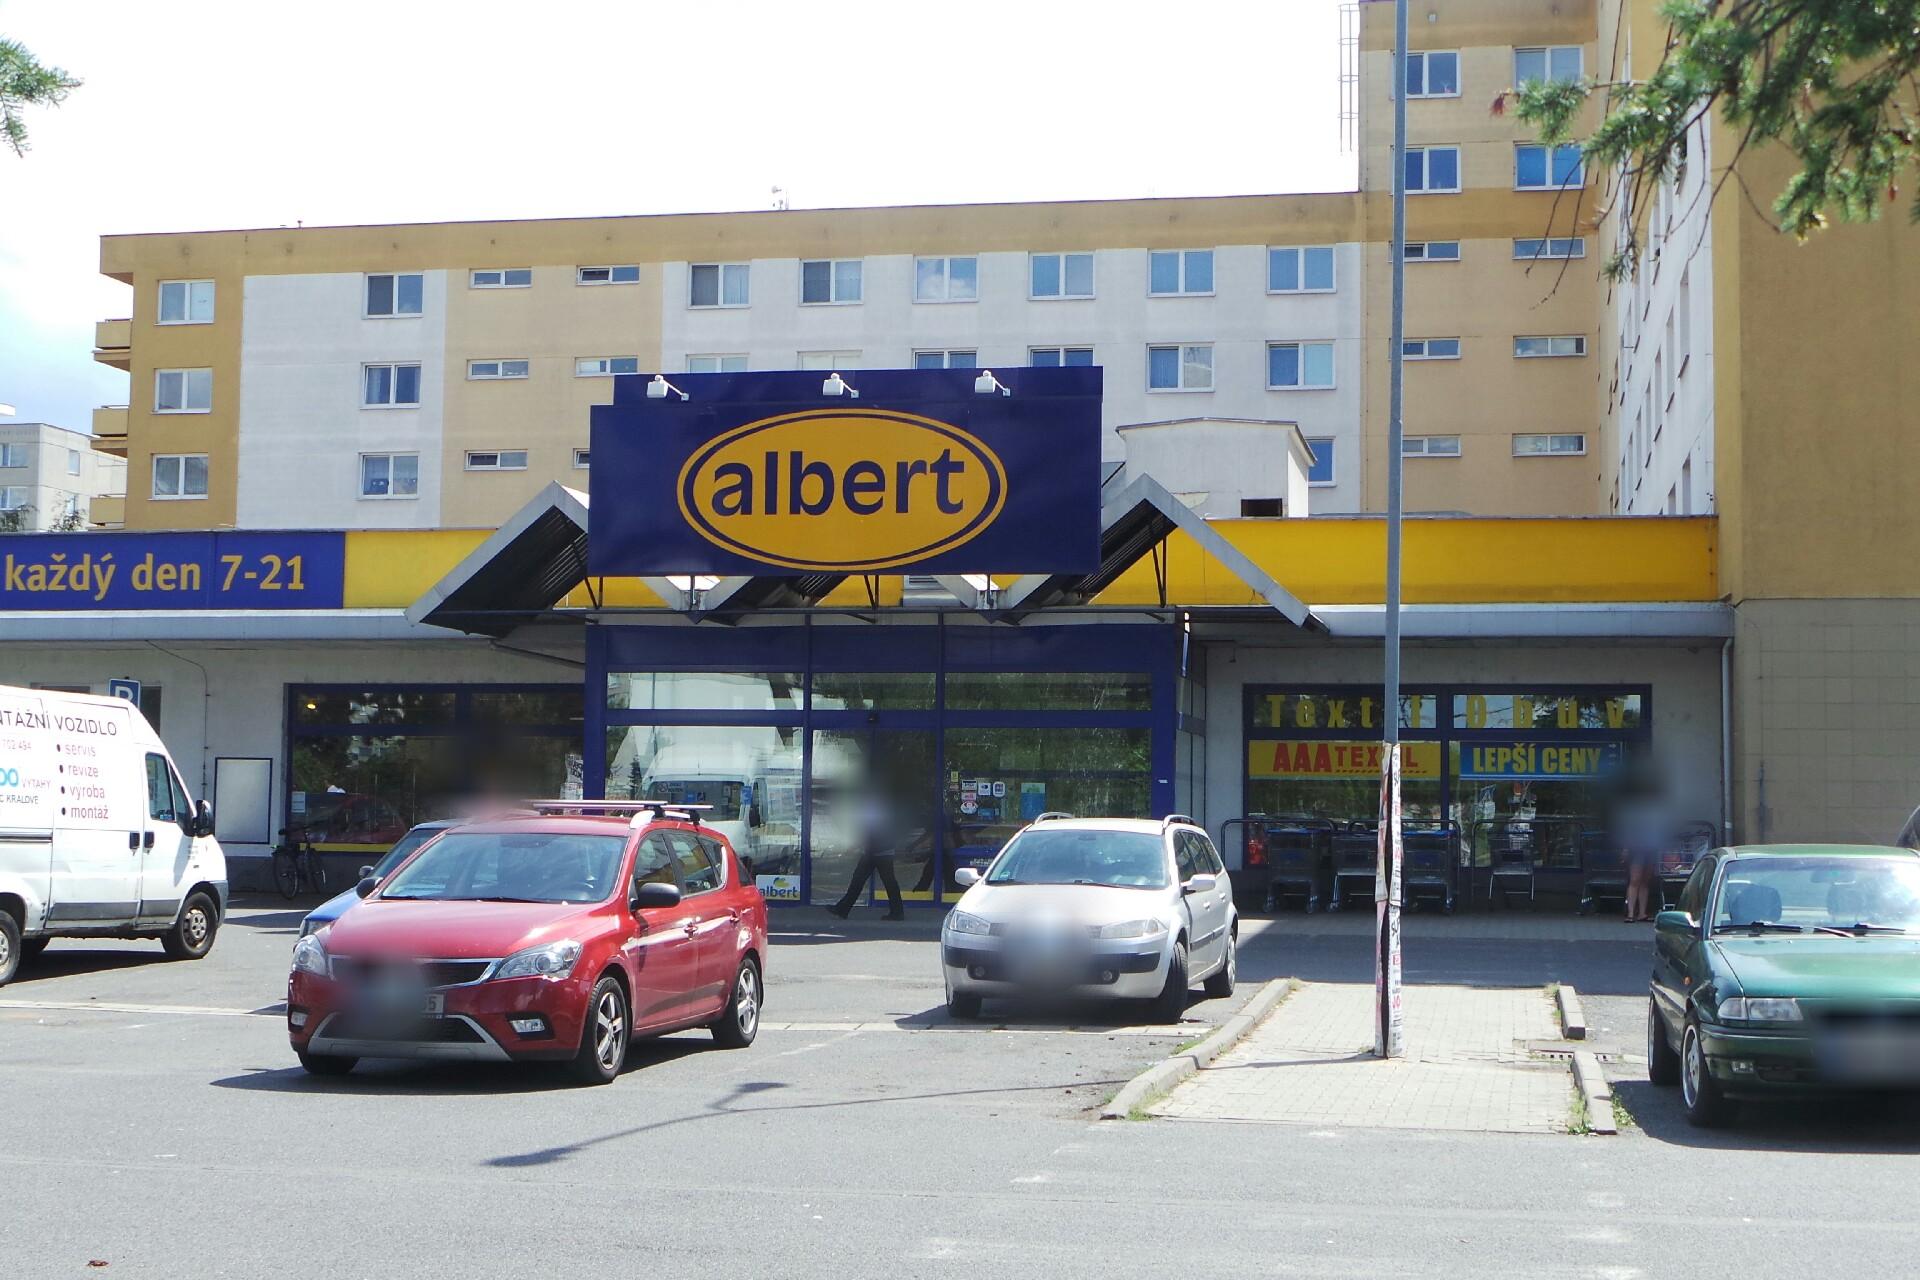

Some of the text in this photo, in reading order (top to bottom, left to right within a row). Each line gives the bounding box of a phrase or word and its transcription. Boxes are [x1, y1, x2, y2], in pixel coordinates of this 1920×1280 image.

[710, 448, 965, 517] albert
[4, 553, 305, 601] každý den 7-21
[0, 707, 117, 736] TÁŽNÍ VOZIDLO
[1266, 694, 1422, 728] Textl
[64, 743, 97, 757] servis
[1473, 742, 1536, 773] LEPŠÍ
[1542, 747, 1601, 773] CENY
[68, 764, 99, 778] revize
[759, 885, 798, 898] albert
